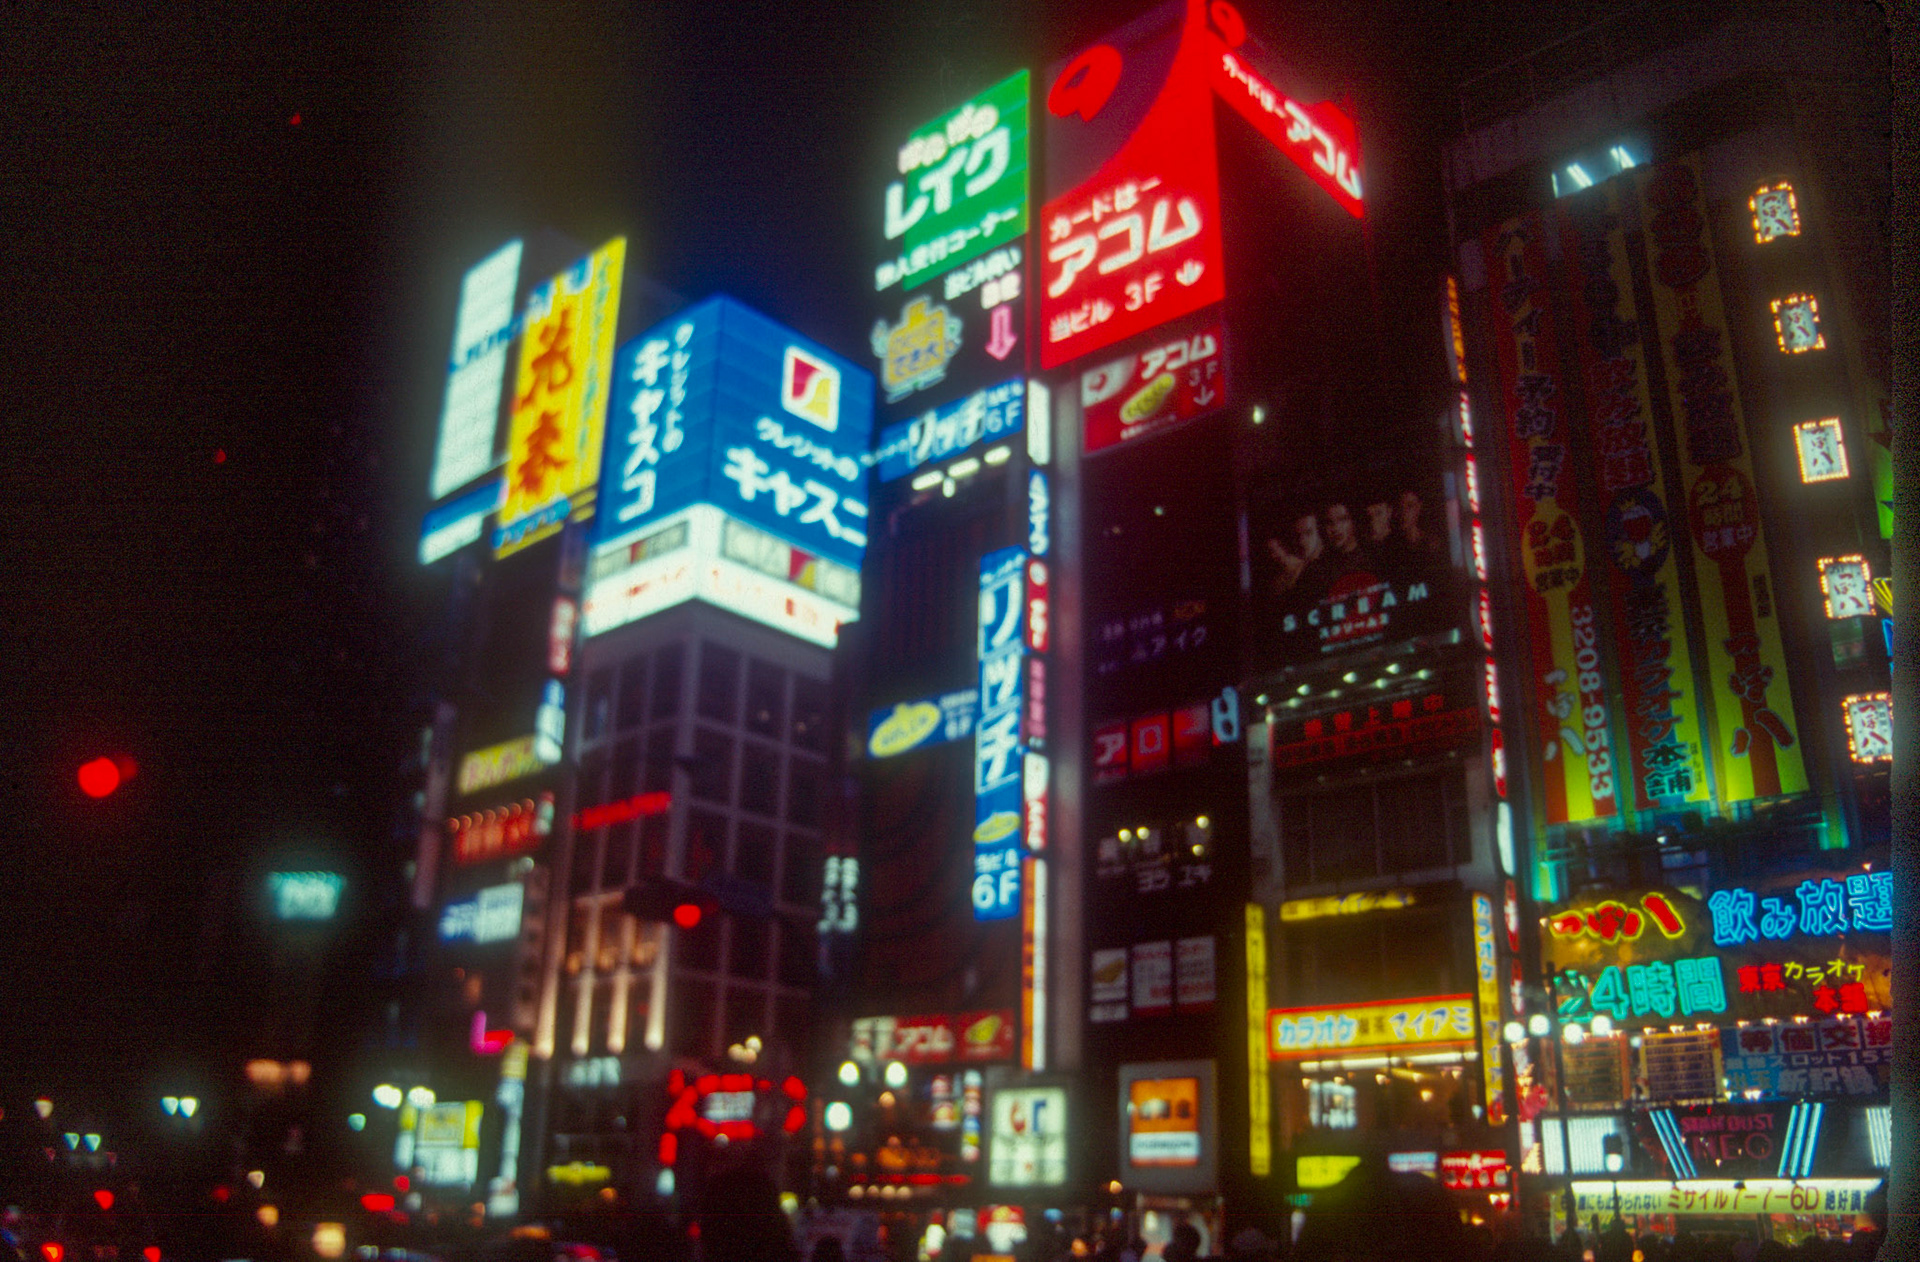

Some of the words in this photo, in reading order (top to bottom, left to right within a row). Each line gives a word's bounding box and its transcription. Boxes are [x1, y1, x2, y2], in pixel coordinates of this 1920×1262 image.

[884, 126, 1010, 240] レイク
[1285, 100, 1363, 200] アコム
[1048, 198, 1201, 298] アコム
[1049, 298, 1114, 343] 当ビル
[1125, 272, 1164, 312] 3F
[1142, 335, 1216, 380] アコム
[978, 573, 1024, 794] リッチ
[1572, 604, 1614, 800] 3208-9533
[971, 870, 1020, 911] 6F
[1550, 891, 1687, 946] つぼ八
[1708, 871, 1893, 946] 飲み放題
[1784, 958, 1865, 986] カラオケ
[1278, 1014, 1358, 1048] カラオケ
[1389, 1006, 1474, 1041] マイアミ
